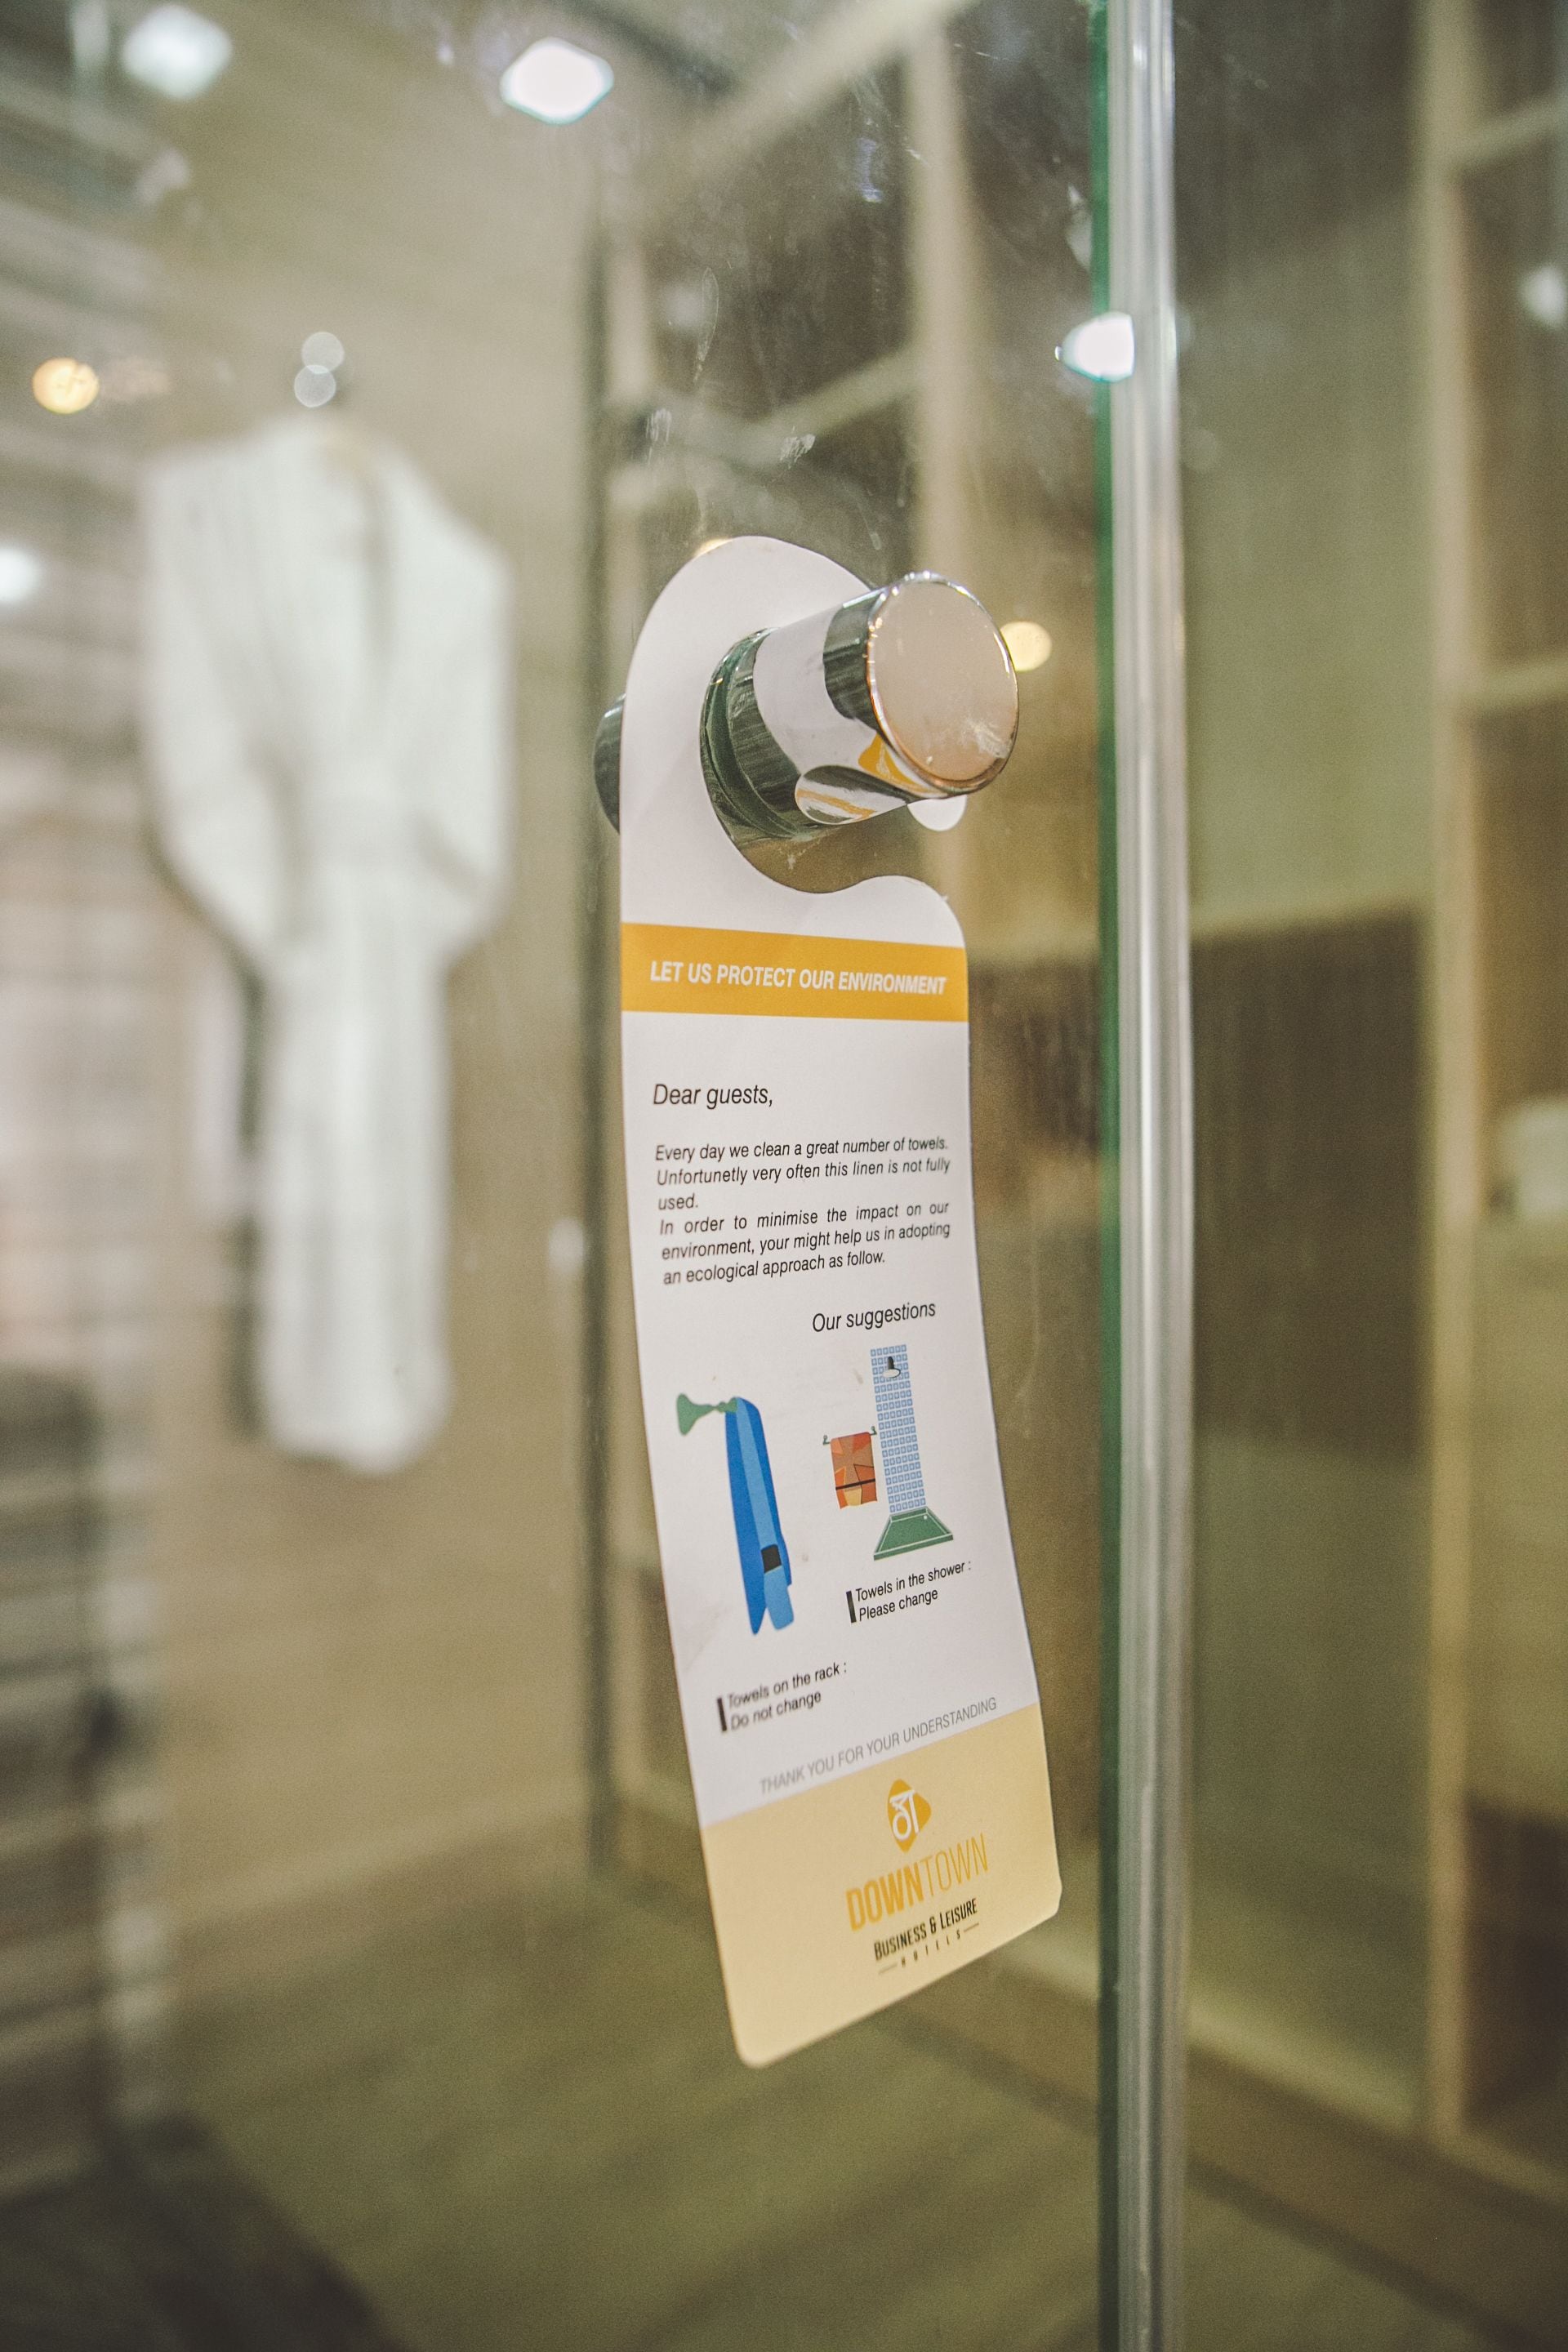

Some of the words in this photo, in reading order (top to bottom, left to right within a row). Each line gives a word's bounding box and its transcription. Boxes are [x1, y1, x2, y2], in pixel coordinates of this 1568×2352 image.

[650, 961, 684, 982] LET
[688, 963, 713, 984] US
[716, 964, 795, 987] PROTECT
[800, 969, 834, 989] OUR
[838, 972, 947, 995] ENVIRONMENT
[653, 1084, 702, 1104] Dear
[706, 1084, 773, 1110] guests,
[656, 1145, 695, 1163] Every
[700, 1144, 725, 1162] day
[729, 1146, 749, 1157] we
[754, 1142, 790, 1156] clean
[794, 1144, 802, 1155] a
[806, 1140, 839, 1158] great
[843, 1138, 890, 1153] number
[893, 1138, 905, 1151] of
[908, 1136, 947, 1151] towels.
[657, 1166, 748, 1185] Unfortunetly
[753, 1168, 782, 1183] very
[786, 1163, 820, 1178] often
[825, 1163, 848, 1177] this
[853, 1161, 884, 1175] linen
[889, 1160, 898, 1174] is
[902, 1160, 922, 1172] not
[926, 1157, 951, 1174] fully
[658, 1193, 698, 1210] used.
[660, 1219, 674, 1235] In
[684, 1217, 724, 1233] order
[734, 1215, 747, 1229] to
[757, 1210, 818, 1227] minimise
[827, 1208, 847, 1223] the
[856, 1205, 898, 1223] impact
[906, 1205, 921, 1216] on
[929, 1203, 949, 1214] our
[662, 1239, 755, 1260] environment,
[760, 1238, 790, 1255] your
[794, 1232, 831, 1250] might
[835, 1229, 862, 1247] help
[866, 1230, 880, 1241] us
[884, 1226, 895, 1240] in
[898, 1223, 951, 1240] adopting
[663, 1272, 681, 1285] an
[686, 1261, 759, 1283] ecological
[763, 1255, 825, 1277] approach
[829, 1255, 843, 1268] as
[847, 1251, 885, 1266] follow.
[812, 1312, 842, 1332] Our
[846, 1303, 936, 1330] suggestions
[856, 1581, 893, 1602] Towels
[896, 1578, 906, 1590] in
[908, 1574, 925, 1587] the
[928, 1562, 965, 1582] shower
[858, 1602, 896, 1622] Please
[898, 1588, 938, 1610] change
[728, 1686, 769, 1708] Towels
[773, 1681, 789, 1695] on
[792, 1674, 811, 1688] the
[814, 1663, 840, 1682] rack
[730, 1713, 749, 1731] Do
[753, 1707, 773, 1722] not
[776, 1691, 822, 1715] change
[760, 1766, 804, 1794] THANK
[807, 1756, 835, 1777] YOU
[838, 1745, 865, 1767] FOR
[866, 1733, 900, 1757] YOUR
[903, 1697, 997, 1743] UNDERSTANDING
[846, 1833, 989, 1932] DOWNTOWN
[929, 1917, 938, 1934] &
